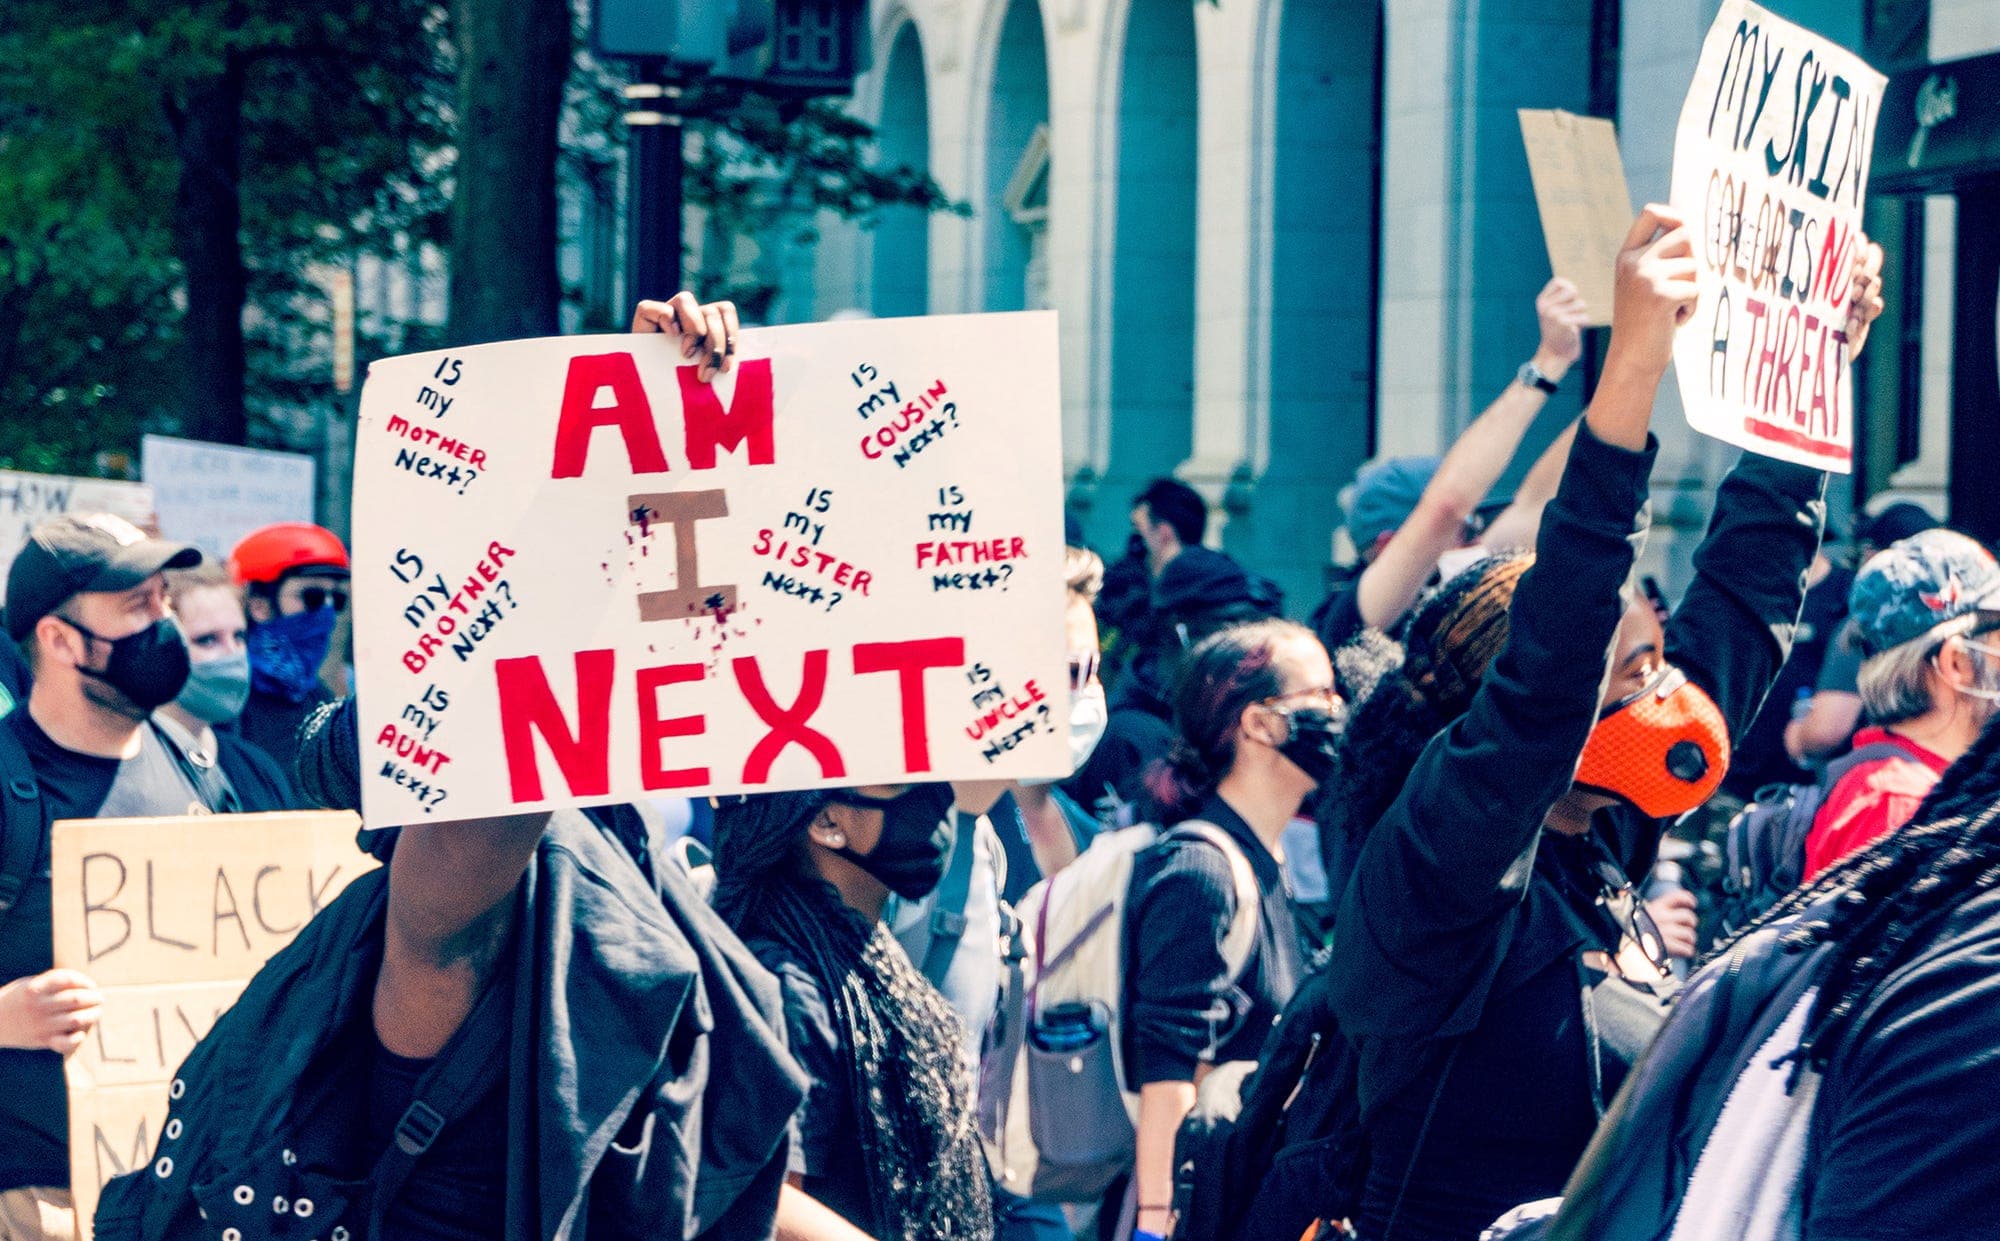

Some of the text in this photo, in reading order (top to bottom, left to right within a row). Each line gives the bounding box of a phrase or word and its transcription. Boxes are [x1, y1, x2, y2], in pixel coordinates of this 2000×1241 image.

[1708, 19, 1870, 209] MY SKIN
[1705, 168, 1785, 296] COLOR
[1780, 208, 1817, 304] IS
[434, 357, 463, 386] IS
[851, 363, 877, 388] IS
[1710, 285, 1850, 437] A THREAT
[551, 352, 775, 479] AM
[860, 379, 947, 460] COUSIN
[893, 403, 959, 467] Next?
[395, 449, 477, 495] Next?
[806, 488, 832, 513] IS
[939, 486, 964, 506] IS
[390, 548, 423, 583] IS
[627, 488, 738, 622] I
[753, 529, 872, 597] SISTER
[916, 537, 1028, 569] FATHER
[932, 564, 1014, 591] Next?
[402, 541, 516, 674] BROTHER
[451, 580, 517, 662] Next?
[762, 571, 842, 612] Next?
[422, 684, 450, 711] IS
[966, 662, 991, 685] IS
[495, 637, 964, 803] NEXT
[966, 679, 1047, 740] UNCLE
[981, 704, 1055, 764] Next?
[377, 724, 451, 775] AUNT
[379, 761, 447, 813] Next?
[82, 852, 342, 962] BLACK
[97, 1005, 220, 1067] LIV
